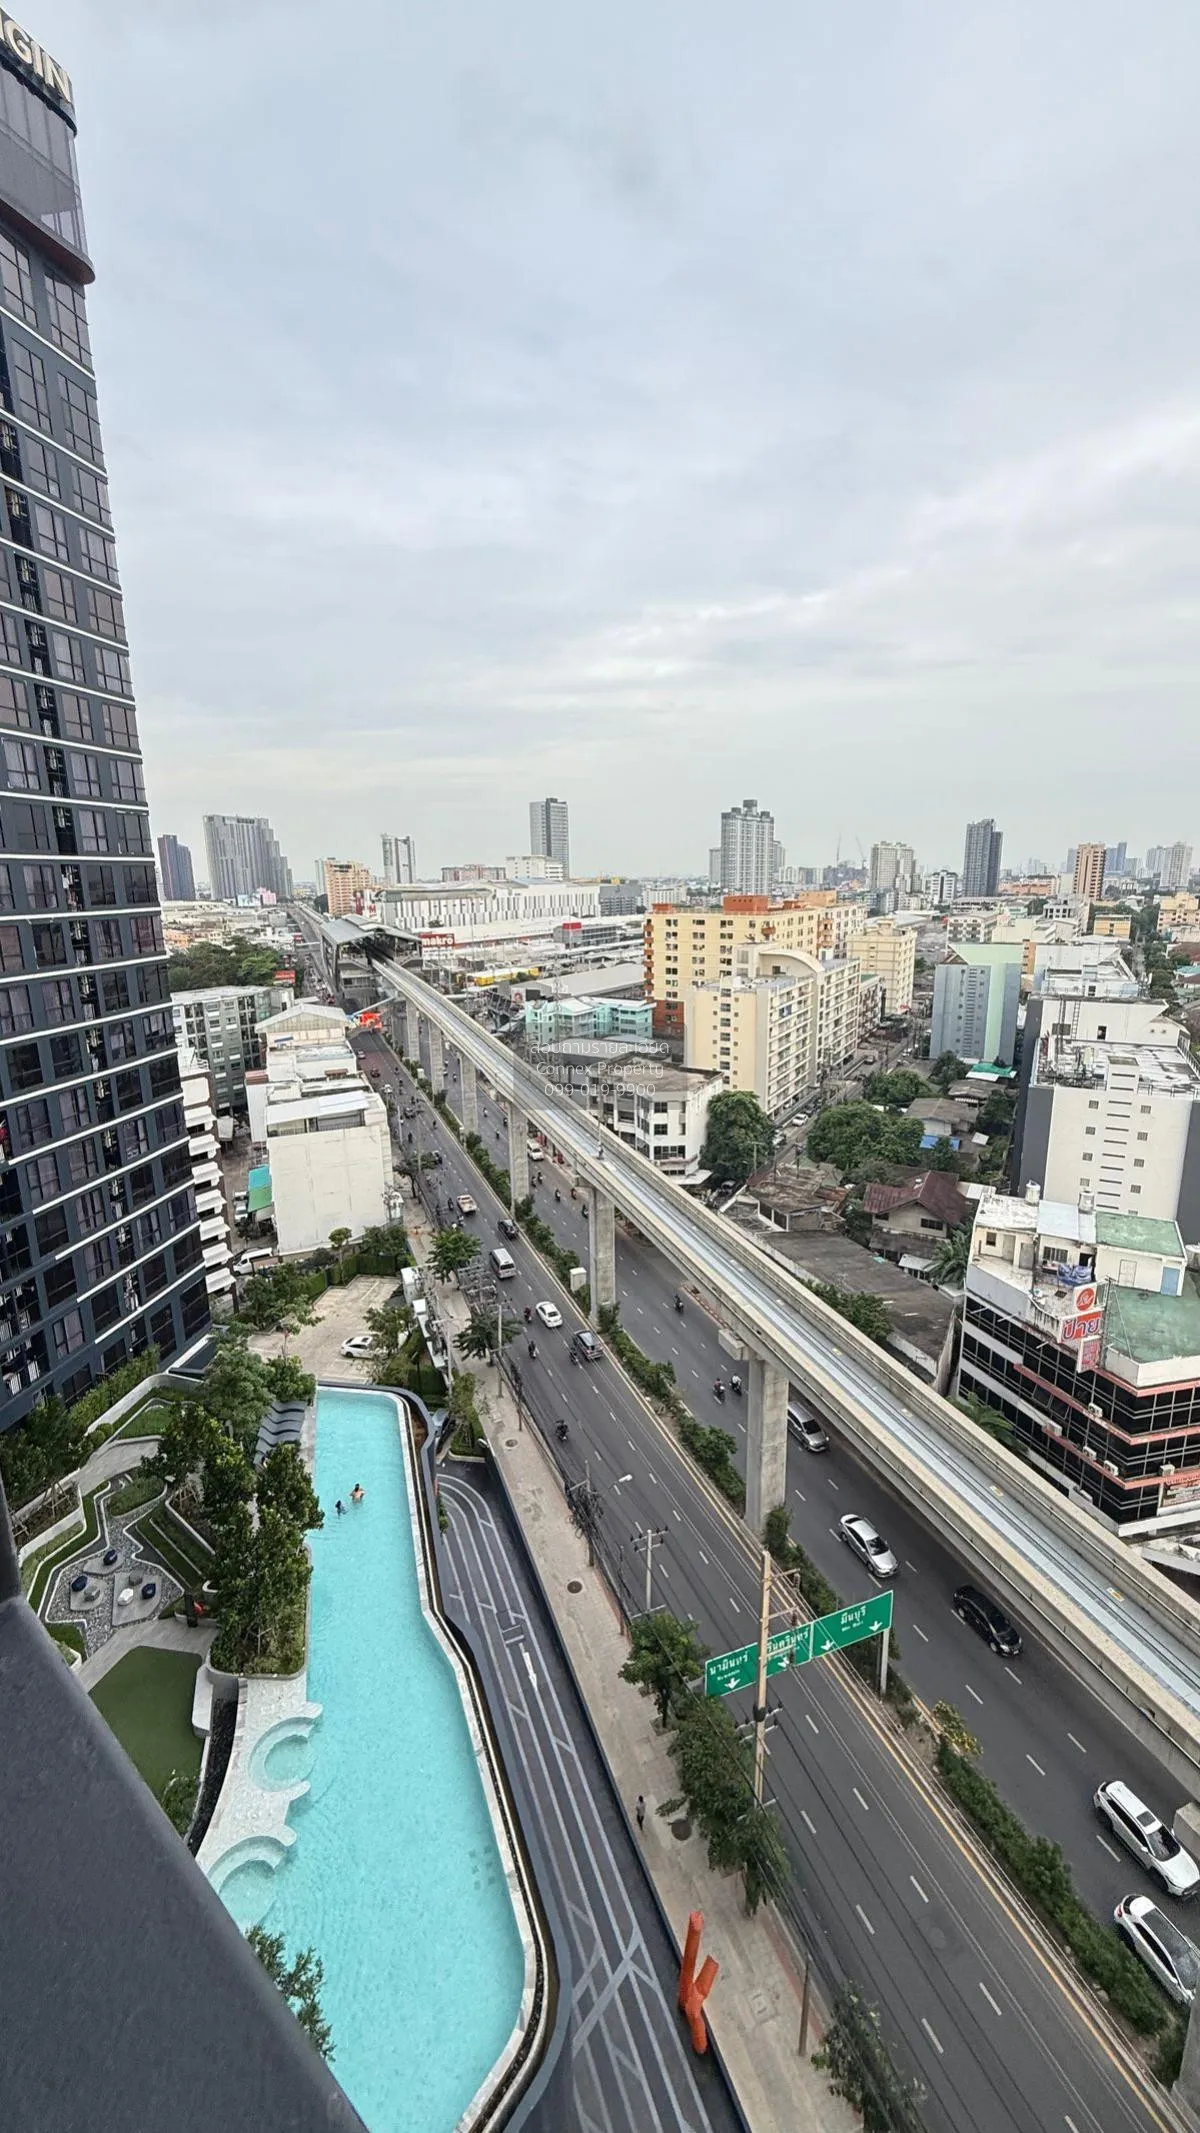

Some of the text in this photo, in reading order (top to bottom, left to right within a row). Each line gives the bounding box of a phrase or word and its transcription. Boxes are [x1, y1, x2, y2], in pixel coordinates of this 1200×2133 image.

[421, 935, 453, 946] makro
[1063, 1317, 1100, 1341] ป้าย
[767, 1627, 809, 1652] รีนครินทร์
